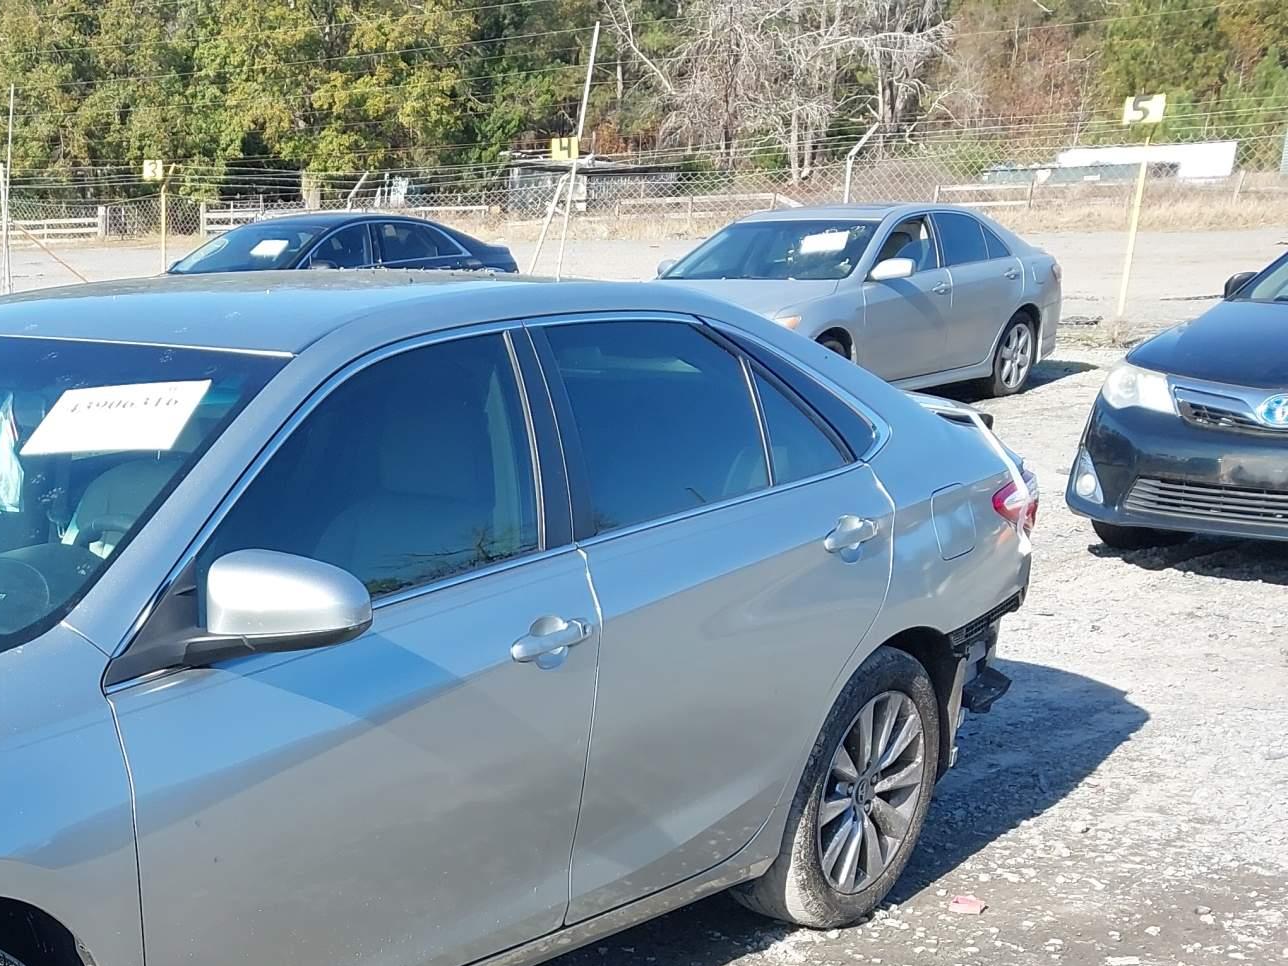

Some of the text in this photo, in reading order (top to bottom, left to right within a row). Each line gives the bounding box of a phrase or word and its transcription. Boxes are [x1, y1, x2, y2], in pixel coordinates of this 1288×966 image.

[1128, 94, 1154, 123] 5
[559, 137, 572, 159] 4
[148, 161, 158, 178] 3
